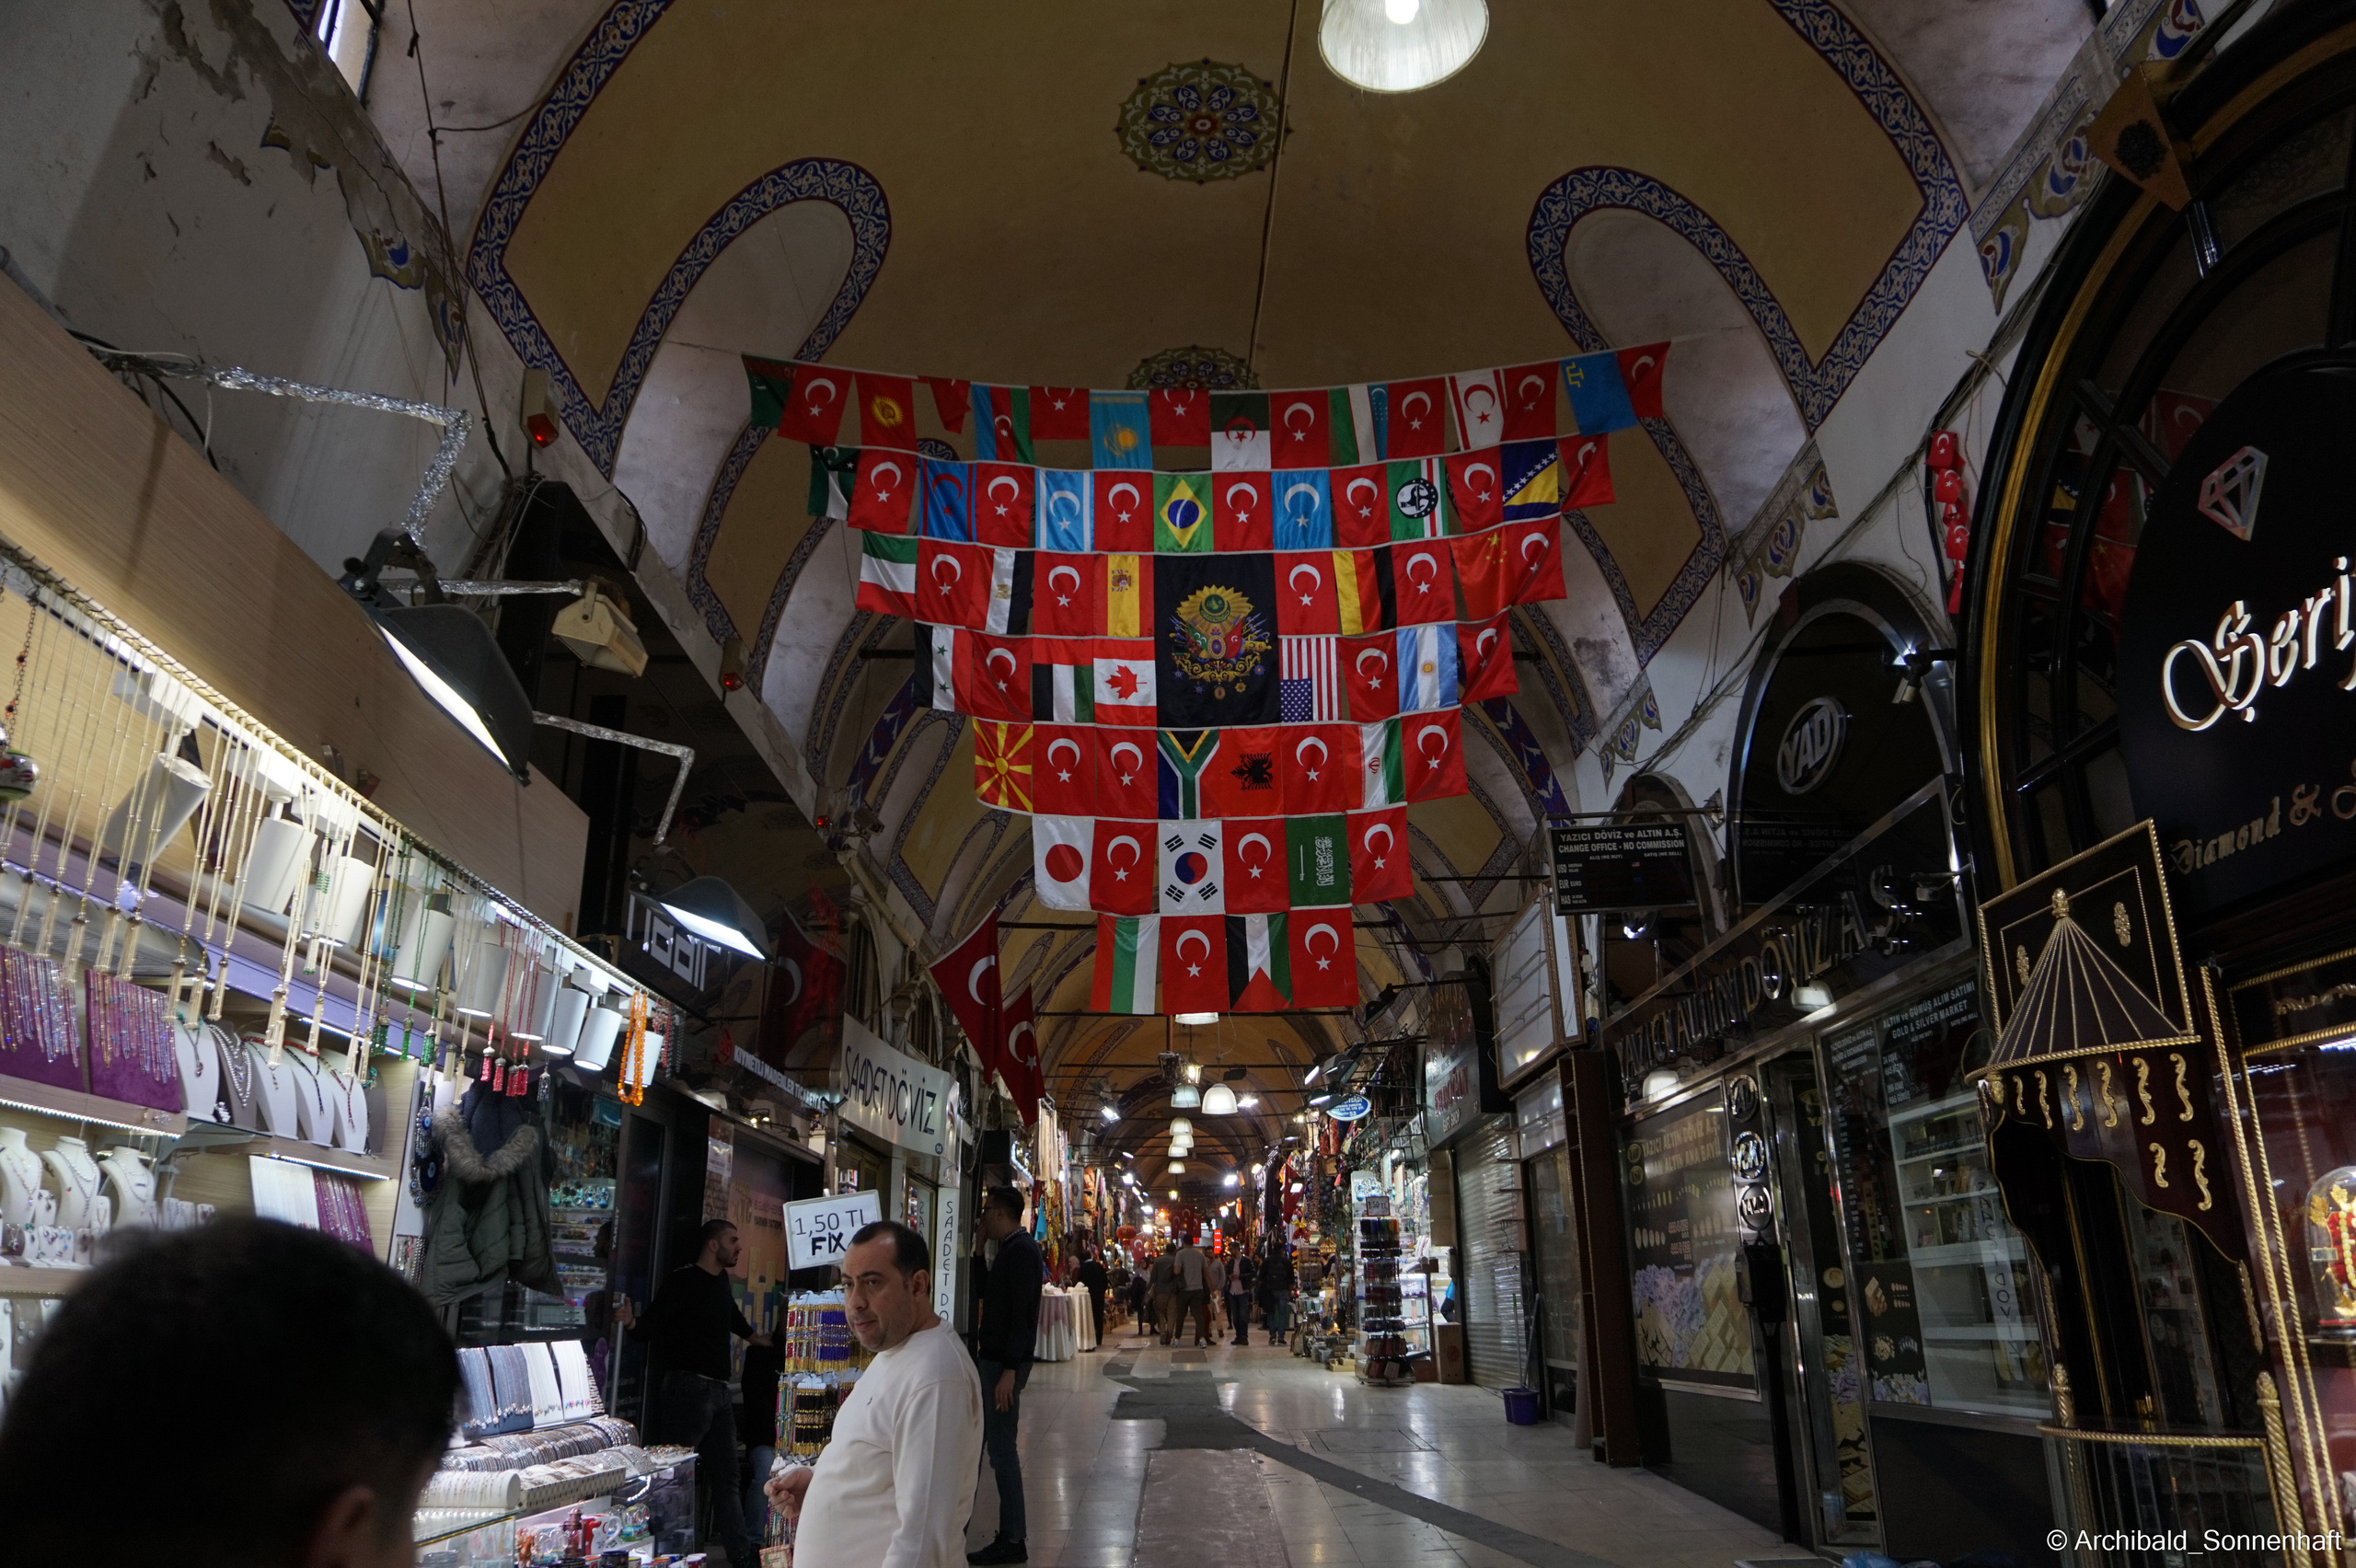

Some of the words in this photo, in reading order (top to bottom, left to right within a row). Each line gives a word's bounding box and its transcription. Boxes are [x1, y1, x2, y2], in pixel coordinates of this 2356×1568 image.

[2163, 555, 2356, 732] Şeri
[1782, 705, 1831, 784] YAD
[1558, 843, 1589, 854] CHANGE
[1590, 842, 1618, 852] OFFICE
[1623, 841, 1634, 850] NO
[1636, 839, 1685, 850] COMMISSION
[1560, 832, 1591, 842] YAZICI
[1594, 829, 1623, 840] DÖVİZ
[1636, 829, 1663, 838] ALTIN
[1665, 828, 1682, 838] A.Ş.
[2168, 795, 2281, 875] Diamond
[2290, 783, 2322, 826] &
[1557, 863, 1567, 873] USD
[1558, 880, 1569, 889] EUR
[1883, 1016, 1901, 1030] ALTIN
[1909, 1000, 1933, 1019] GÜMÜŞ
[1934, 993, 1950, 1009] ALIM
[1950, 980, 1976, 998] SATIMI
[1892, 1027, 1909, 1040] GOLD
[1915, 1013, 1939, 1030] SILVER
[1939, 999, 1969, 1020] MARKET
[843, 1044, 887, 1116] SAADET
[887, 1067, 937, 1136] DÖVİZ
[794, 1213, 839, 1238] 1,50
[845, 1209, 869, 1228] TL
[942, 1201, 953, 1286] SAADET
